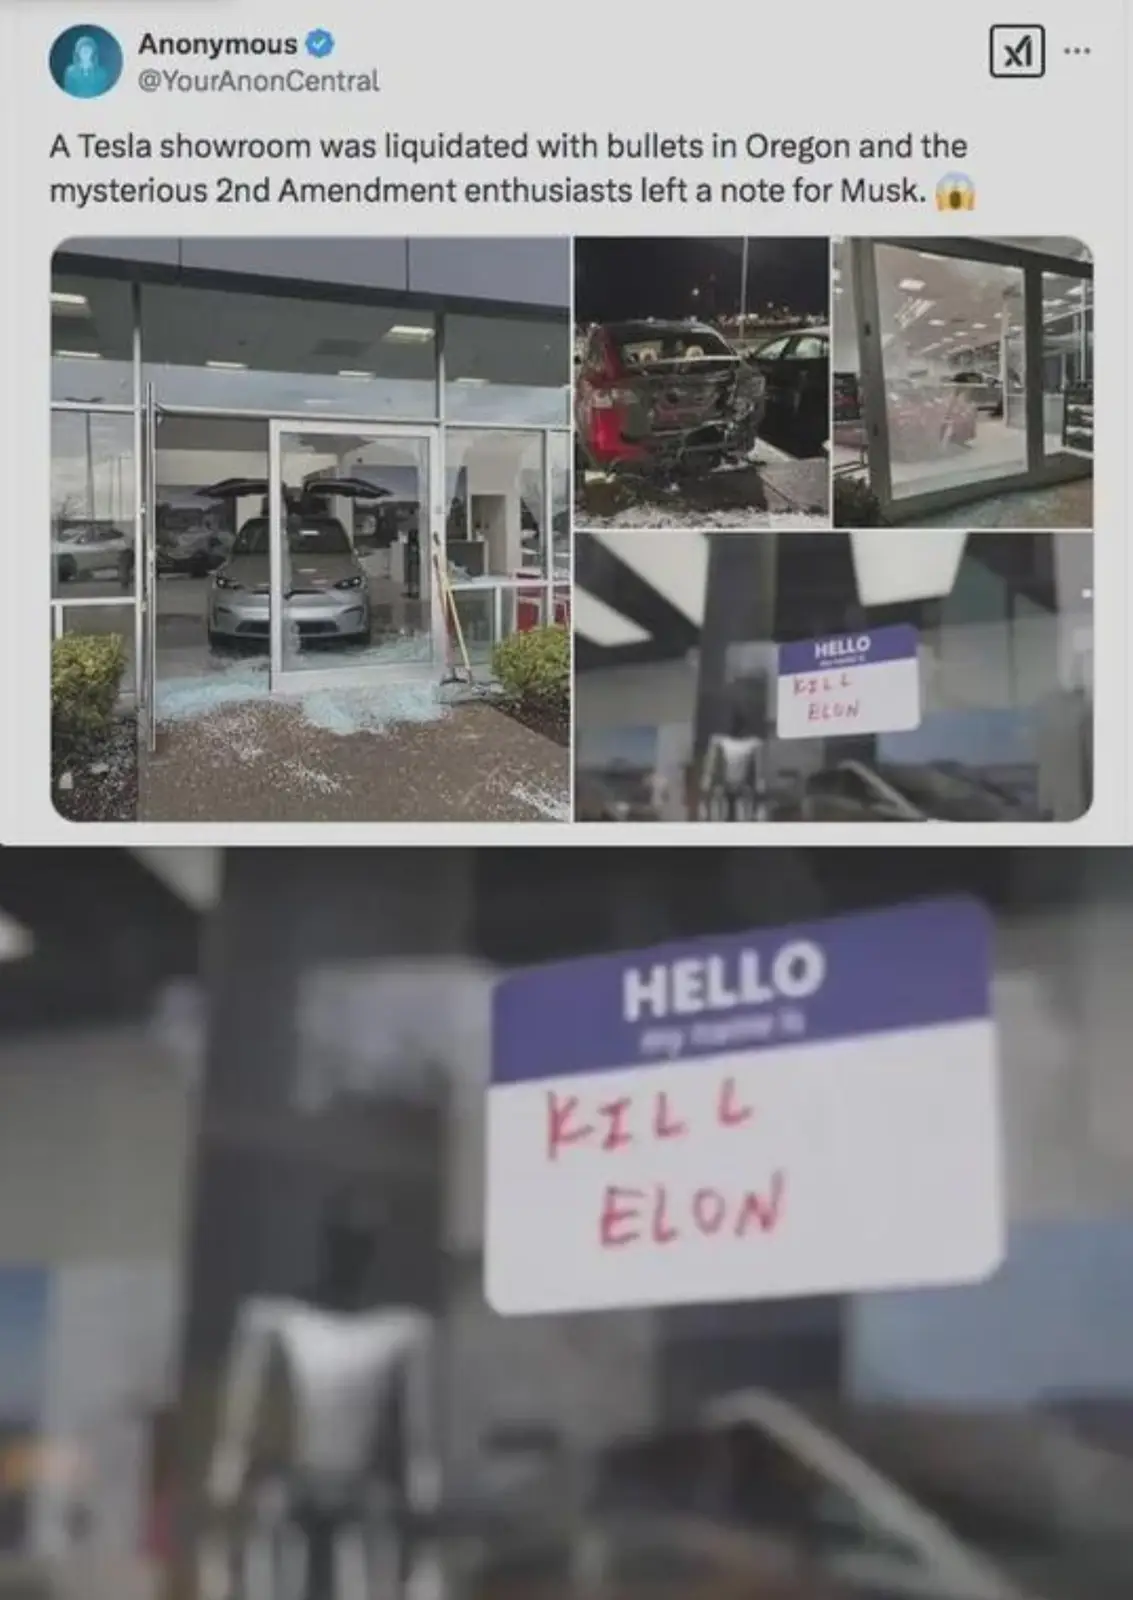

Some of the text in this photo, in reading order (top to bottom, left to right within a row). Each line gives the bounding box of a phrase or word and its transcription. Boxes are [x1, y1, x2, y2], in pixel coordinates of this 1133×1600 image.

[138, 32, 298, 61] Anonymous
[138, 68, 380, 94] @YourAnonCentral
[49, 131, 968, 165] A Tesla showroom was liquidated with bullets in Oregon and the
[50, 175, 927, 209] mysterious 2nd Amendment enthusiasts left a note for Musk.
[814, 635, 871, 660] HELLO
[623, 937, 827, 1023] HELLO
[546, 1076, 755, 1161] KILL
[598, 1169, 787, 1248] ELON
